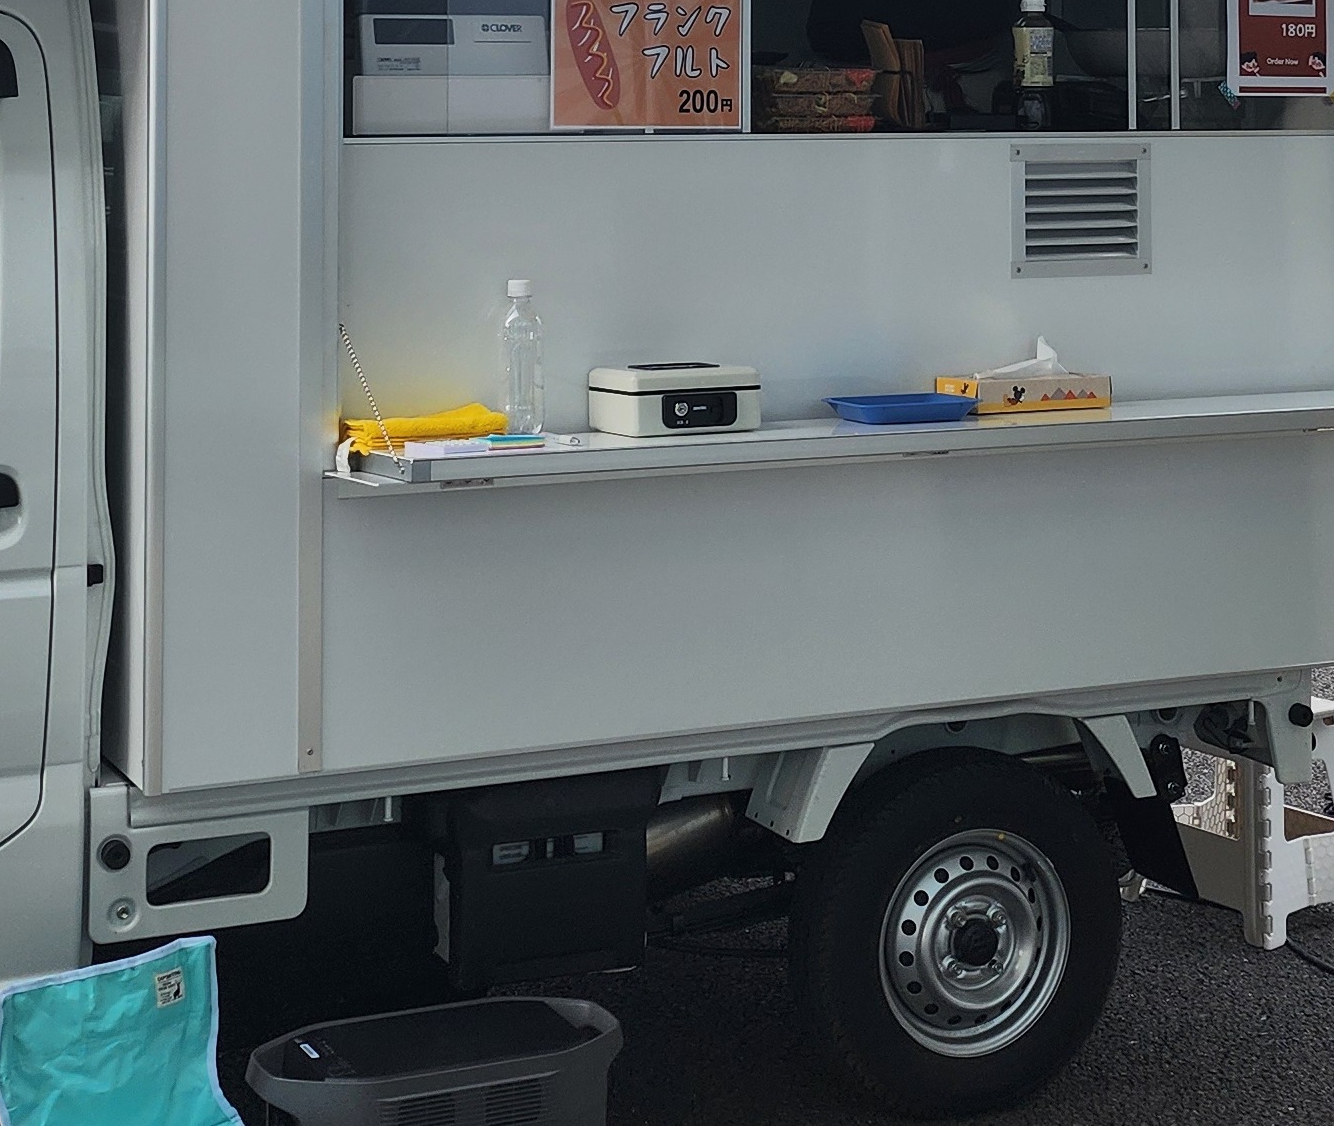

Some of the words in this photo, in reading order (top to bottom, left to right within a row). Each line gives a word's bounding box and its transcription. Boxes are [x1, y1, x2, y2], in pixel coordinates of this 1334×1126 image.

[490, 23, 523, 33] CLOVER
[609, 2, 732, 37] フランク
[1281, 24, 1316, 38] 180円
[641, 44, 731, 79] フルト
[1266, 57, 1284, 65] Order
[1285, 58, 1299, 66] Now
[678, 89, 733, 113] 200円
